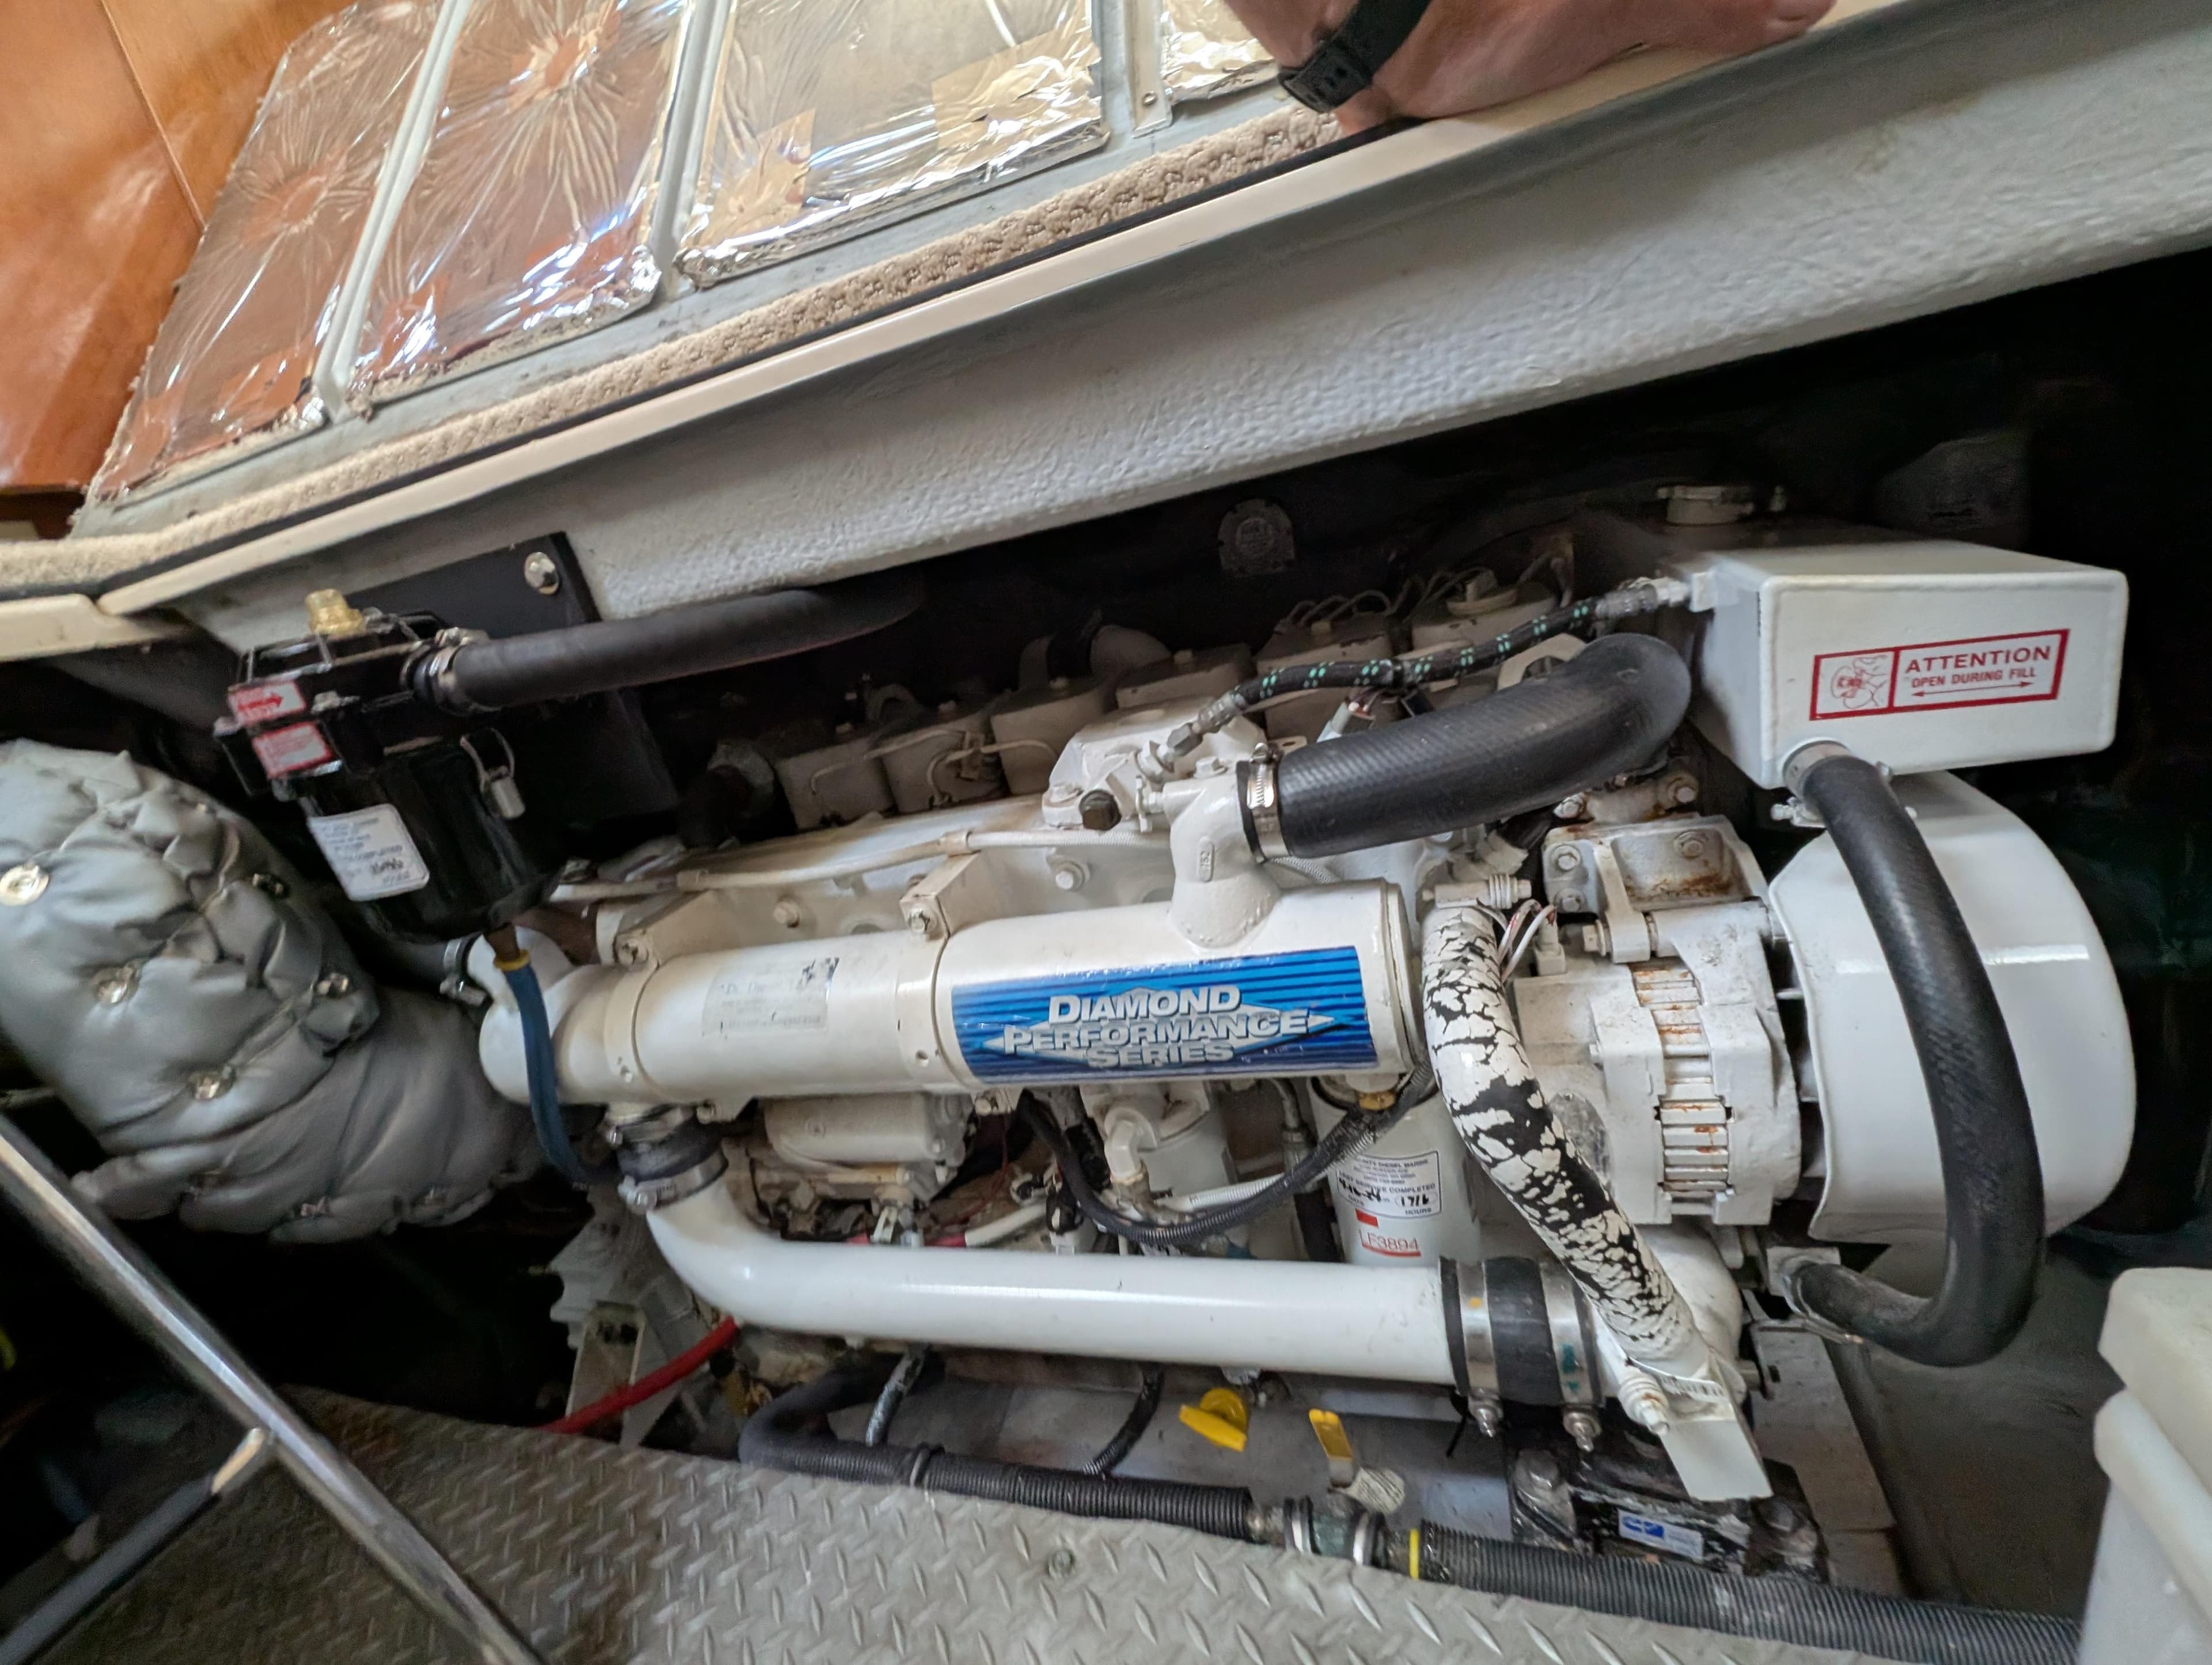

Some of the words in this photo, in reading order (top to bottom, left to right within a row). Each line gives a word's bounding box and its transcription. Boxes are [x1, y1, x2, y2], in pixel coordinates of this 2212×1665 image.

[1905, 646, 2051, 673] ATTENTION
[1912, 676, 1946, 688] OPEN
[1952, 670, 2003, 684] DURING
[2009, 667, 2037, 679] FILL
[1048, 985, 1243, 1023] DIAMOND
[1003, 1010, 1310, 1055] PERFORMANCE
[1086, 1042, 1236, 1068] SERIES
[1389, 1183, 1435, 1193] COMPLETED
